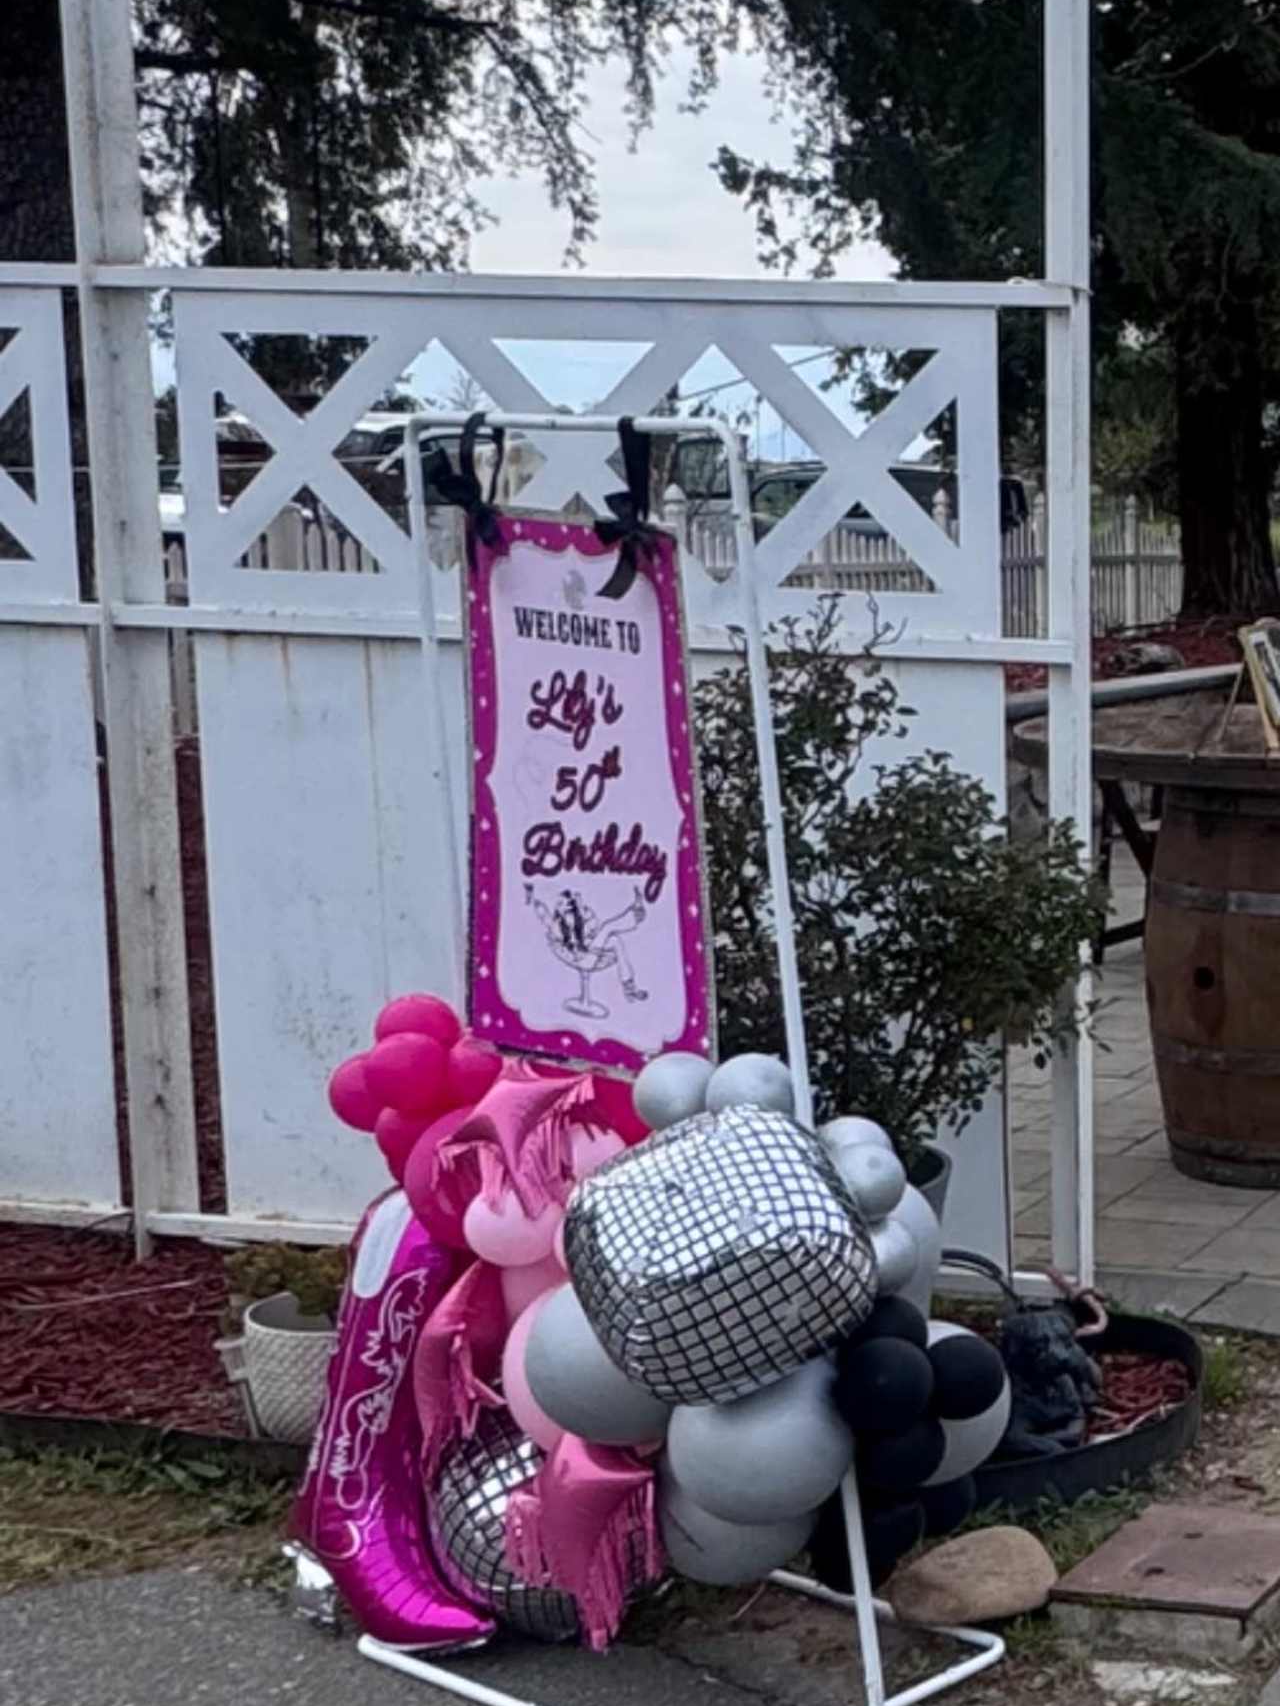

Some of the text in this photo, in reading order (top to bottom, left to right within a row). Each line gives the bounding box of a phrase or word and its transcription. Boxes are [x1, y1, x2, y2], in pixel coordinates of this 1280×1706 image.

[514, 606, 641, 655] WELCOME TO
[526, 669, 624, 751] Lily's
[521, 821, 668, 904] Birthday
